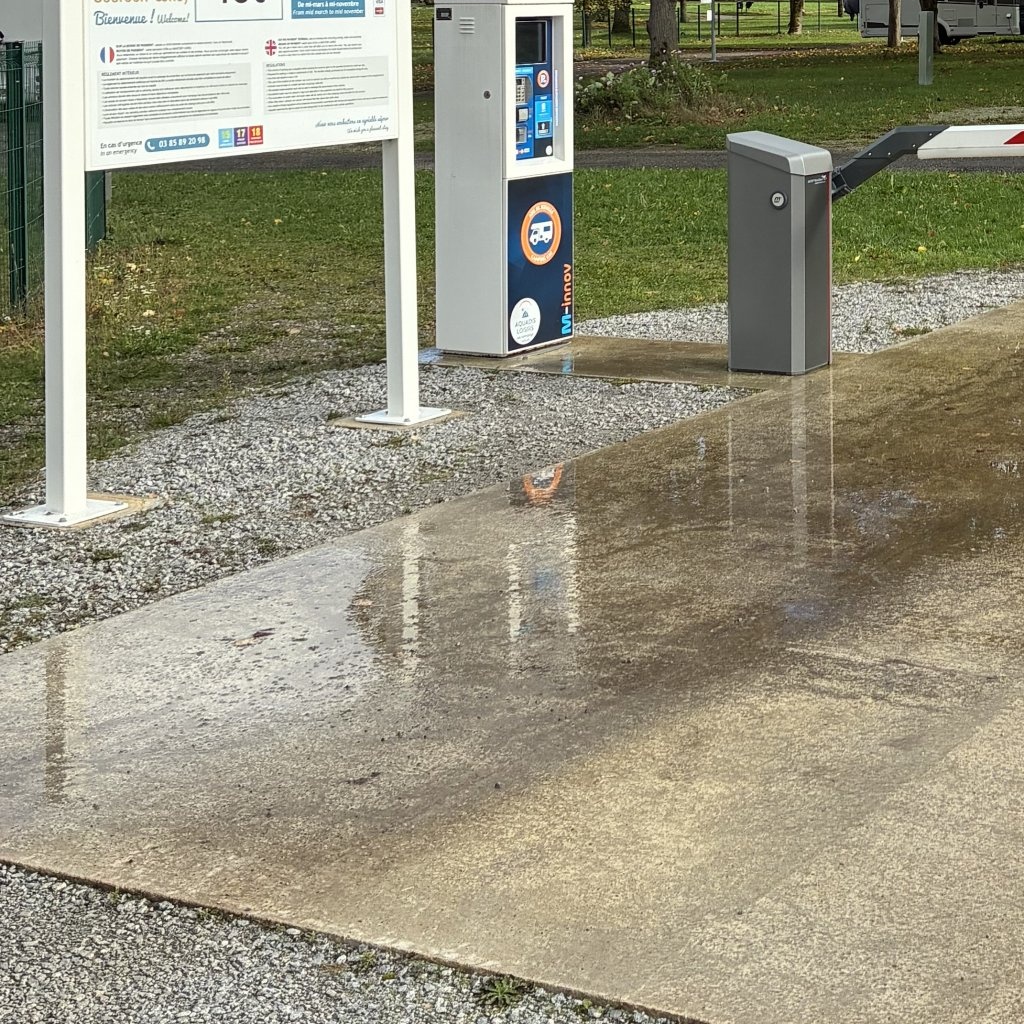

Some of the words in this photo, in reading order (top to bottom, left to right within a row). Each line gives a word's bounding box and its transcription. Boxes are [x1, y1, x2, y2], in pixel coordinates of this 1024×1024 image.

[305, 0, 325, 8] mi-mars
[93, 10, 148, 26] Bienvenue
[156, 13, 190, 24] Welcome!
[236, 129, 246, 137] 17
[251, 127, 261, 136] 18
[117, 140, 142, 149] d'urgence
[159, 140, 168, 148] 03
[168, 139, 178, 147] 85
[178, 138, 187, 146] 89
[188, 137, 197, 145] 20
[197, 136, 206, 145] 98
[561, 263, 572, 335] M-innov
